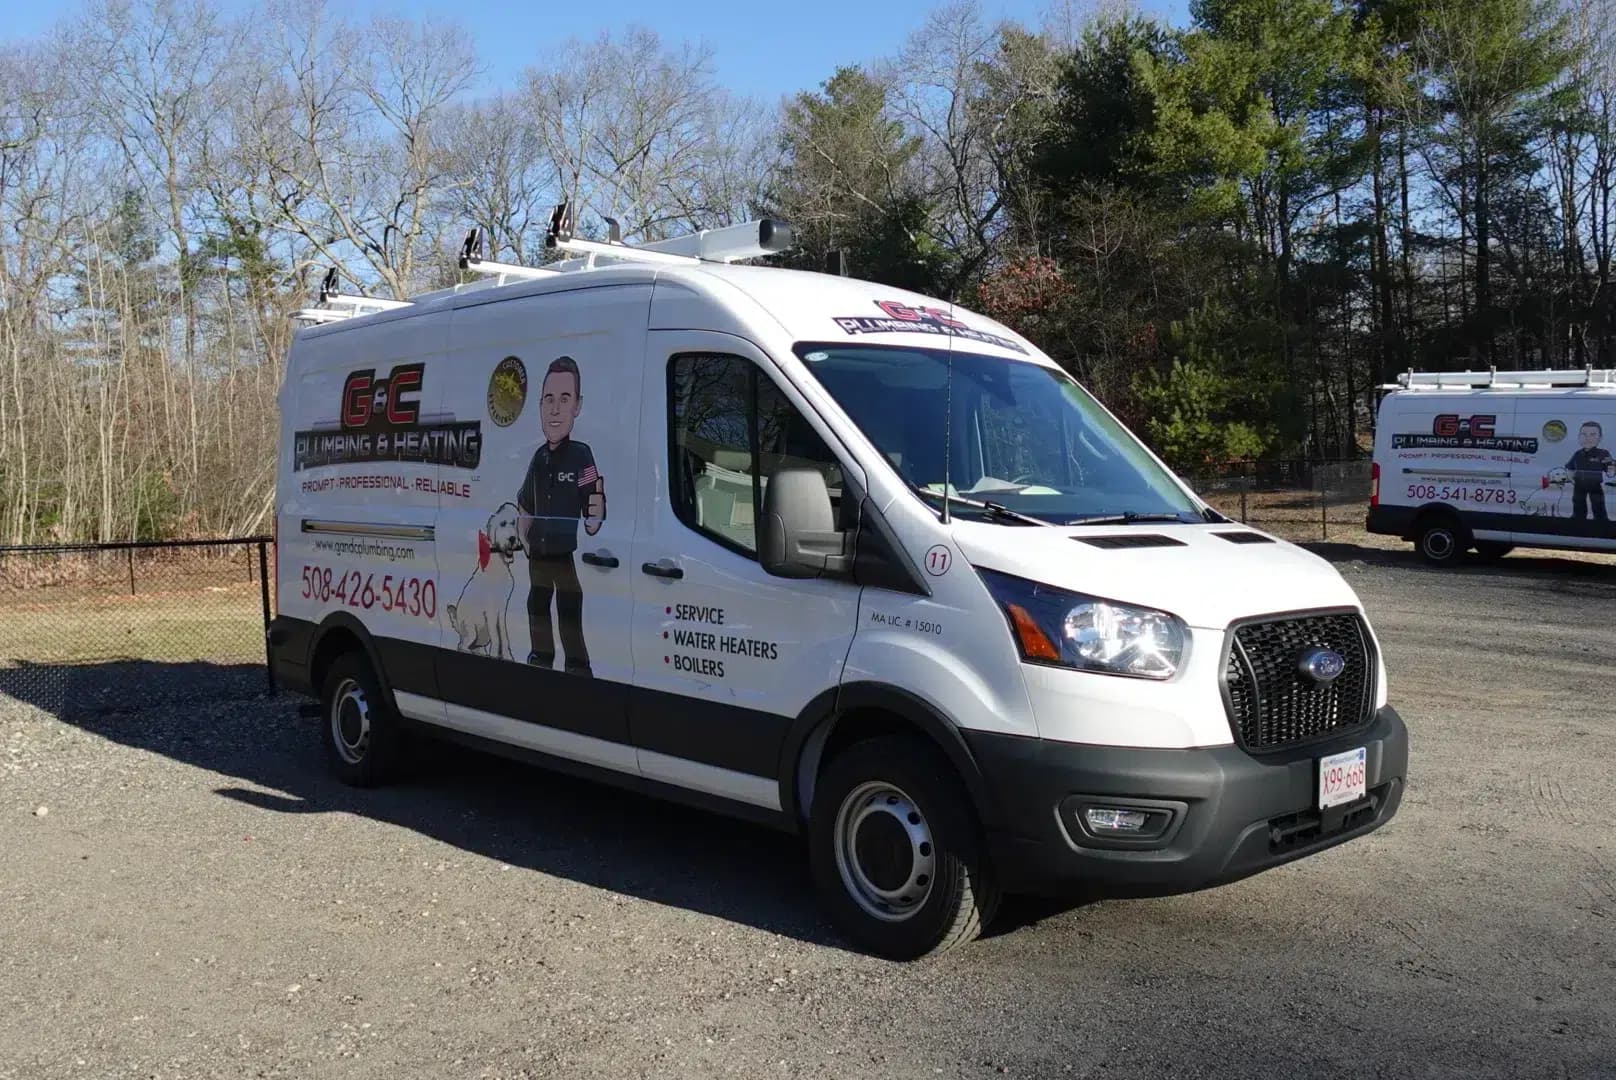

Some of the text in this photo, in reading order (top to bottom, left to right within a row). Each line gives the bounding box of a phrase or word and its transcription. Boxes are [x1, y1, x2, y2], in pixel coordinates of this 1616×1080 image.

[835, 317, 939, 334] PLUMBING
[343, 369, 422, 428] G&C
[296, 430, 478, 463] PLUMBING & HEATING
[1394, 436, 1458, 447] PLUMBING
[1479, 439, 1537, 451] HEATING
[302, 476, 471, 498] PROMPT PROFESSIONAL RELIABLE
[1407, 485, 1517, 504] 508-541-8783
[315, 539, 416, 561] www.gandcplumbing.com
[929, 553, 947, 570] 11
[302, 565, 437, 619] 508-426-5430
[675, 604, 725, 625] SERVICE
[871, 612, 886, 625] MA
[905, 619, 912, 628] #
[914, 619, 942, 635] 15010
[674, 630, 778, 660] WATER HEATERS
[674, 655, 725, 678] BOILERS
